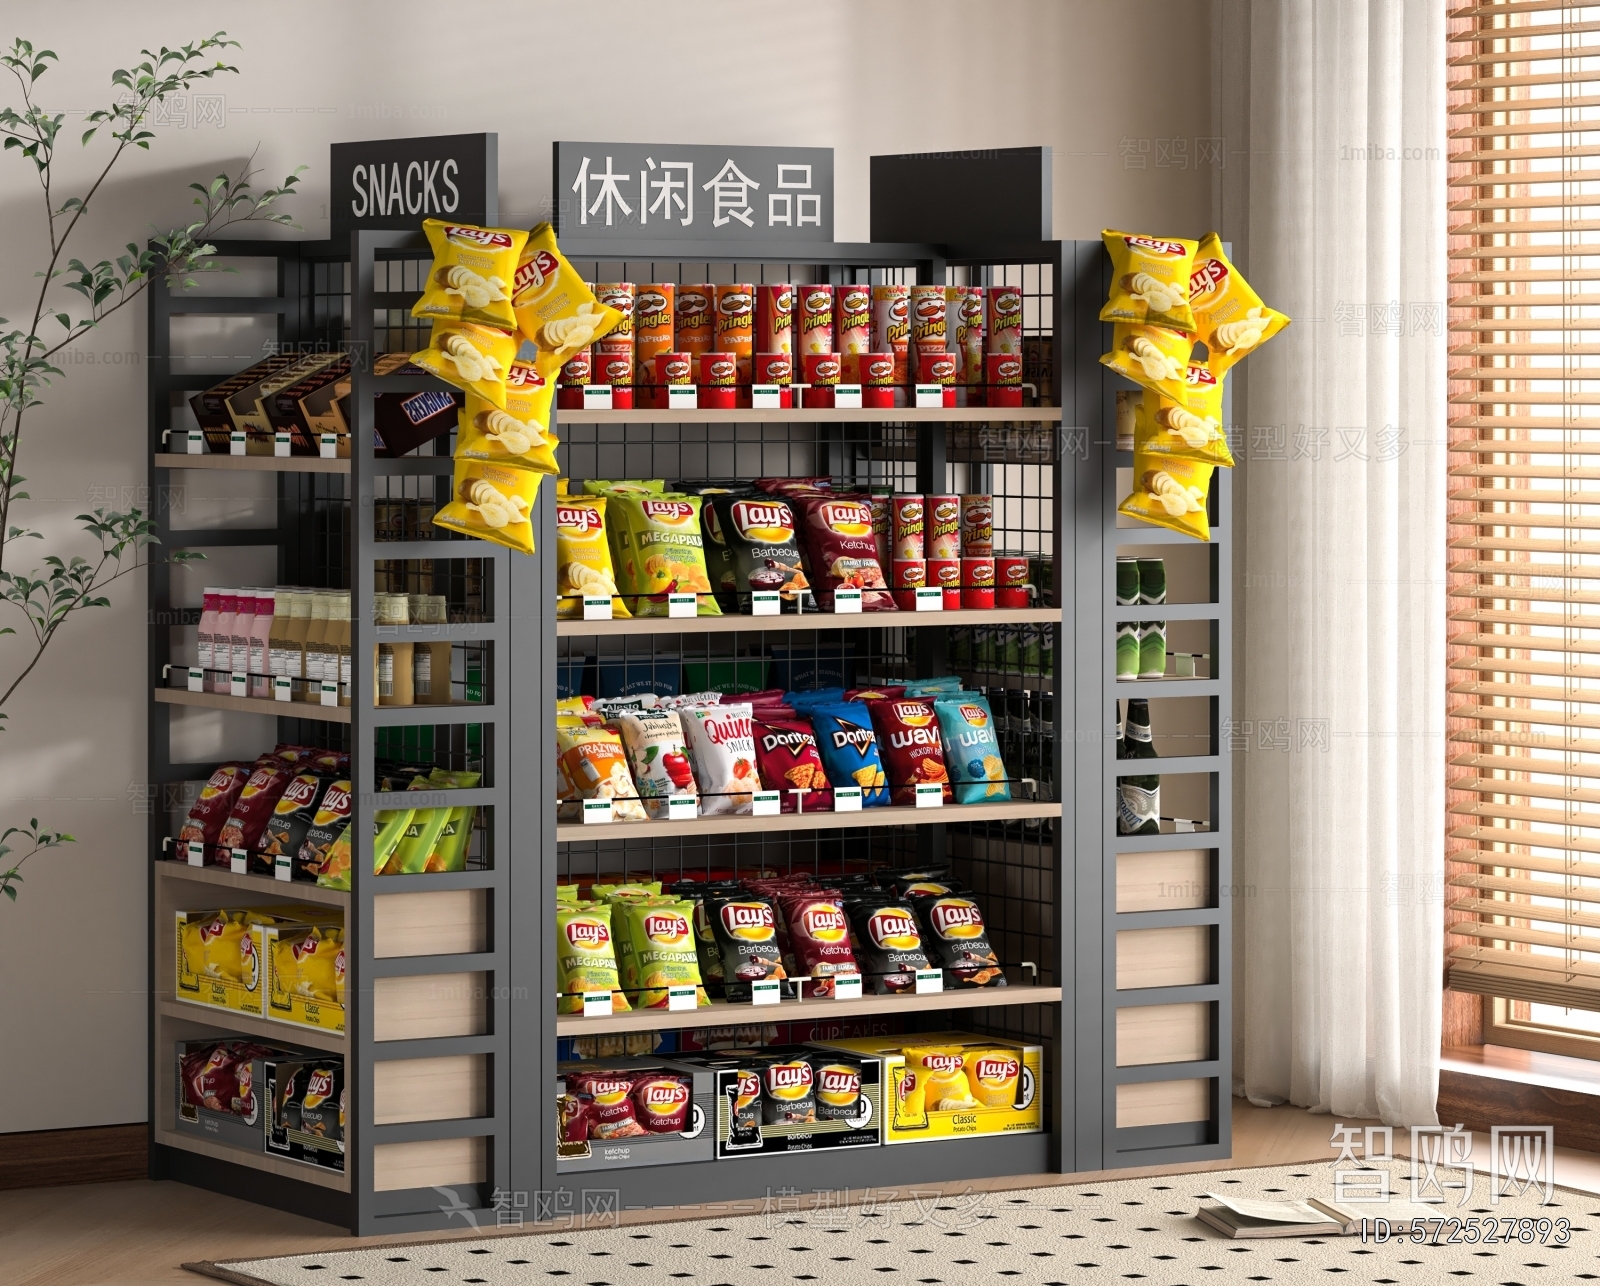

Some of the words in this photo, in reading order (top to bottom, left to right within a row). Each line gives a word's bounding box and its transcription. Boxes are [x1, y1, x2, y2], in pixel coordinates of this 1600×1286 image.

[352, 158, 460, 217] SNACKS
[571, 156, 821, 228] 休闲食品
[557, 508, 599, 532] ay's
[742, 501, 792, 531] Lay's
[829, 503, 871, 525] Lay's
[752, 546, 799, 559] Barbecue
[840, 540, 876, 553] Ketchup
[898, 702, 929, 719] Lay's
[962, 706, 987, 722] Lay's
[649, 916, 686, 939] Lay's
[729, 906, 773, 930] Lay's
[808, 910, 844, 931] Lay's
[876, 915, 917, 941] Lay's
[936, 904, 980, 931] Lay's
[571, 924, 607, 944] Lay's
[819, 946, 851, 957] Ketchup
[927, 1056, 962, 1073] Lay's
[978, 1058, 1016, 1081] Lay's
[770, 1063, 811, 1091] Lay's
[818, 1072, 860, 1094] Lay's
[592, 1081, 629, 1097] Lay's
[647, 1086, 684, 1105] Lay's
[599, 1106, 630, 1118] Ketchup
[649, 1117, 681, 1127] Ketchup
[952, 1114, 977, 1125] Classic
